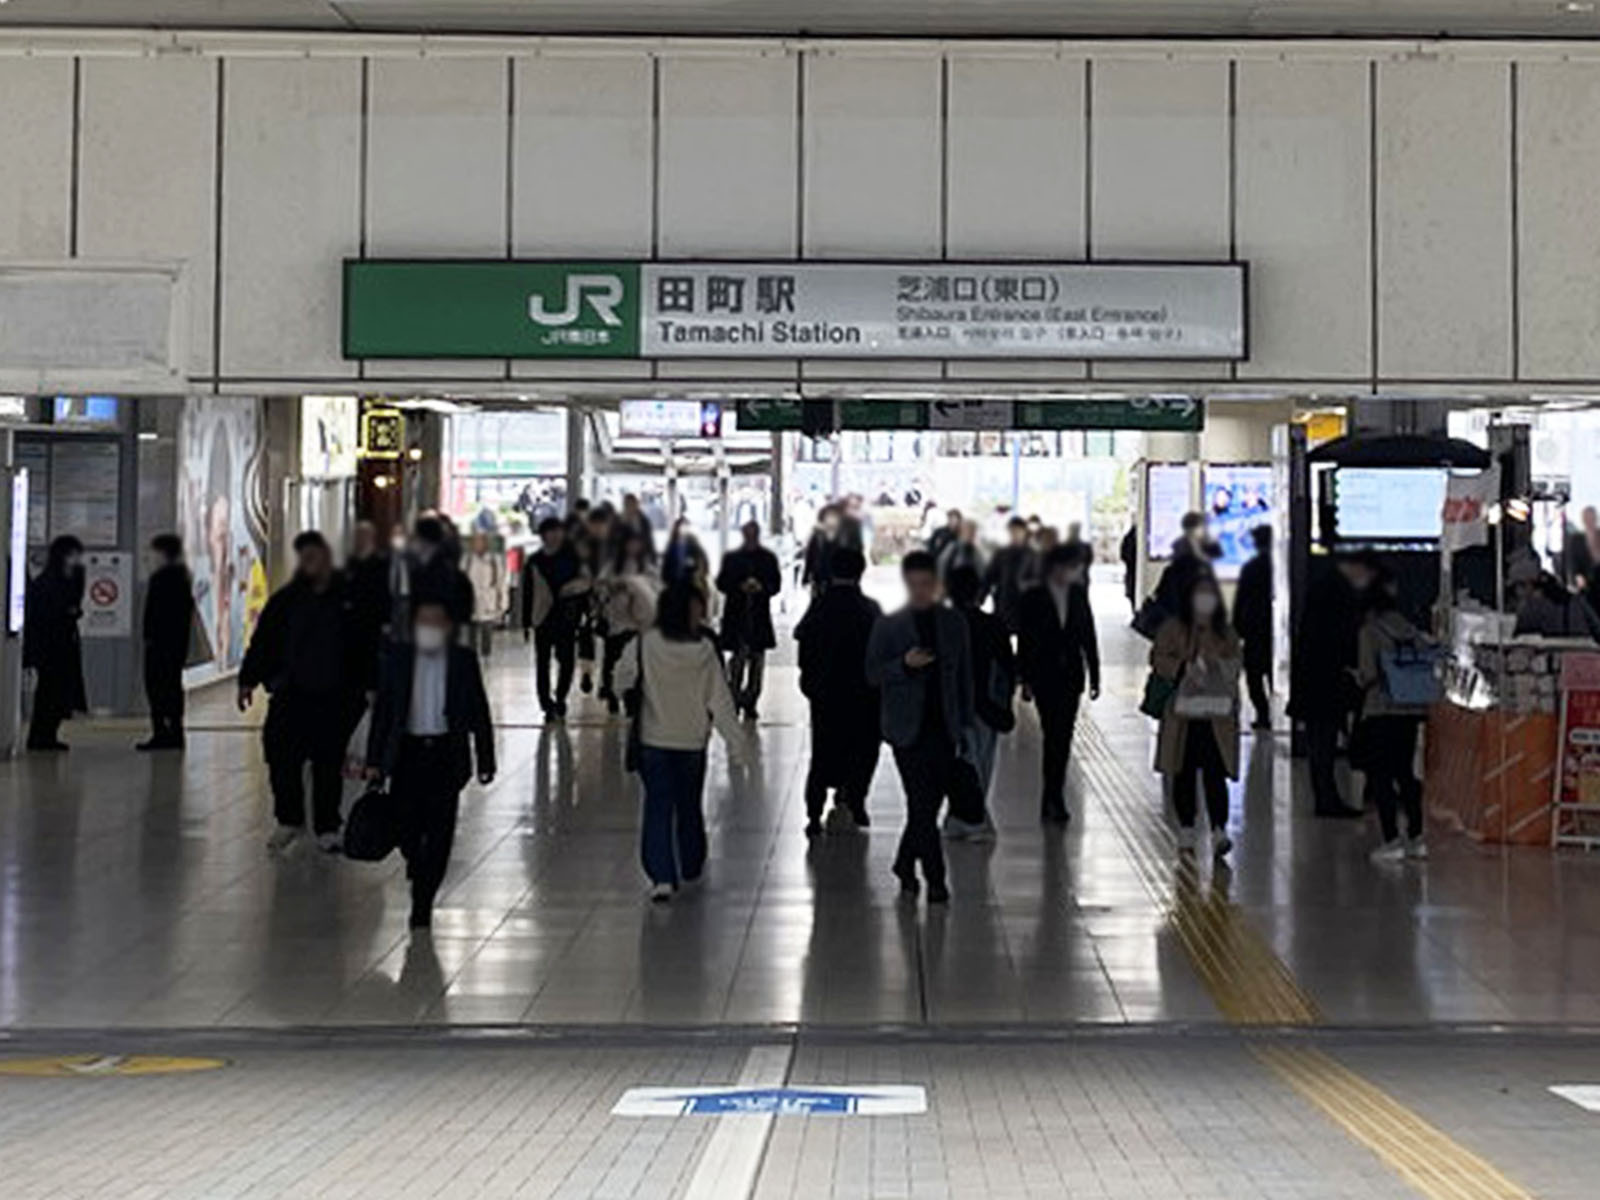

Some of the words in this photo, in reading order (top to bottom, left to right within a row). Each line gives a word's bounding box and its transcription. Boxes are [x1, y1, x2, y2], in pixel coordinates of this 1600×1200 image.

[528, 274, 623, 326] JR
[658, 276, 796, 313] 田町駅
[897, 306, 967, 322] Shibaura
[971, 306, 1041, 322] Entrance
[659, 321, 764, 343] Tamachi
[772, 321, 861, 344] Station
